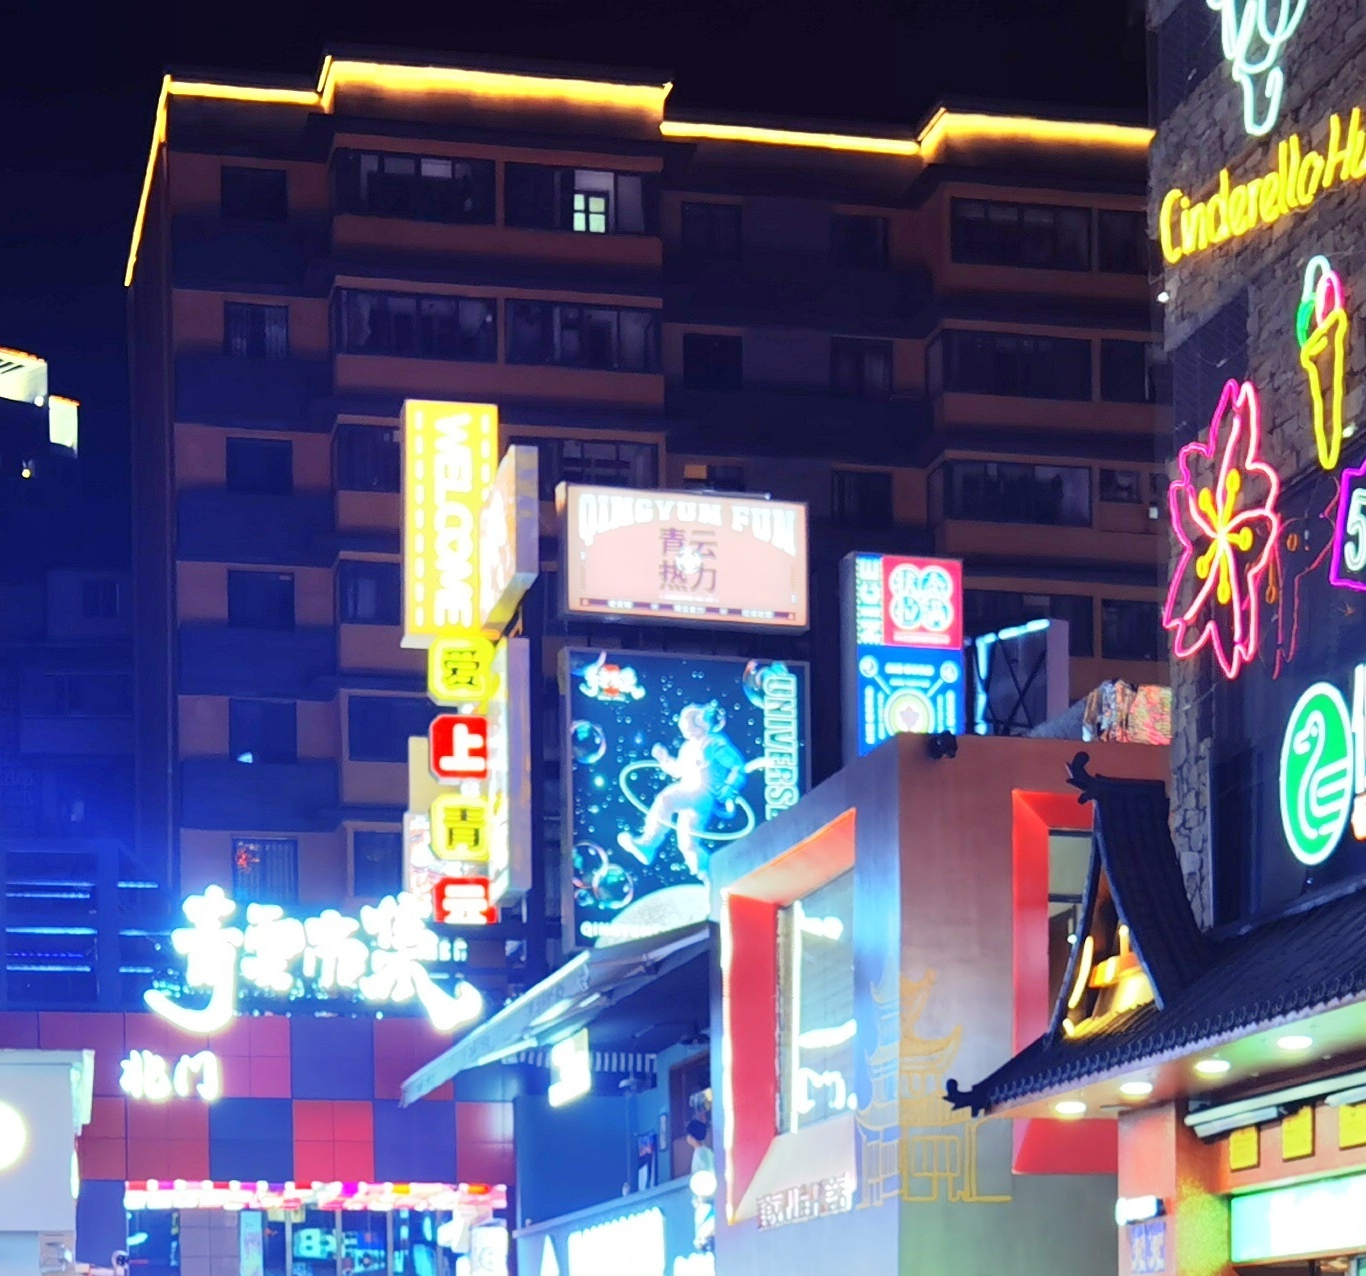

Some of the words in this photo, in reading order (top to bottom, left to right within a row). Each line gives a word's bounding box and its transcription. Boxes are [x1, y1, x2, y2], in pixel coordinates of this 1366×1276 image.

[432, 411, 475, 630] WELCOME
[731, 505, 797, 557] FUN
[120, 1049, 222, 1101] 北门
